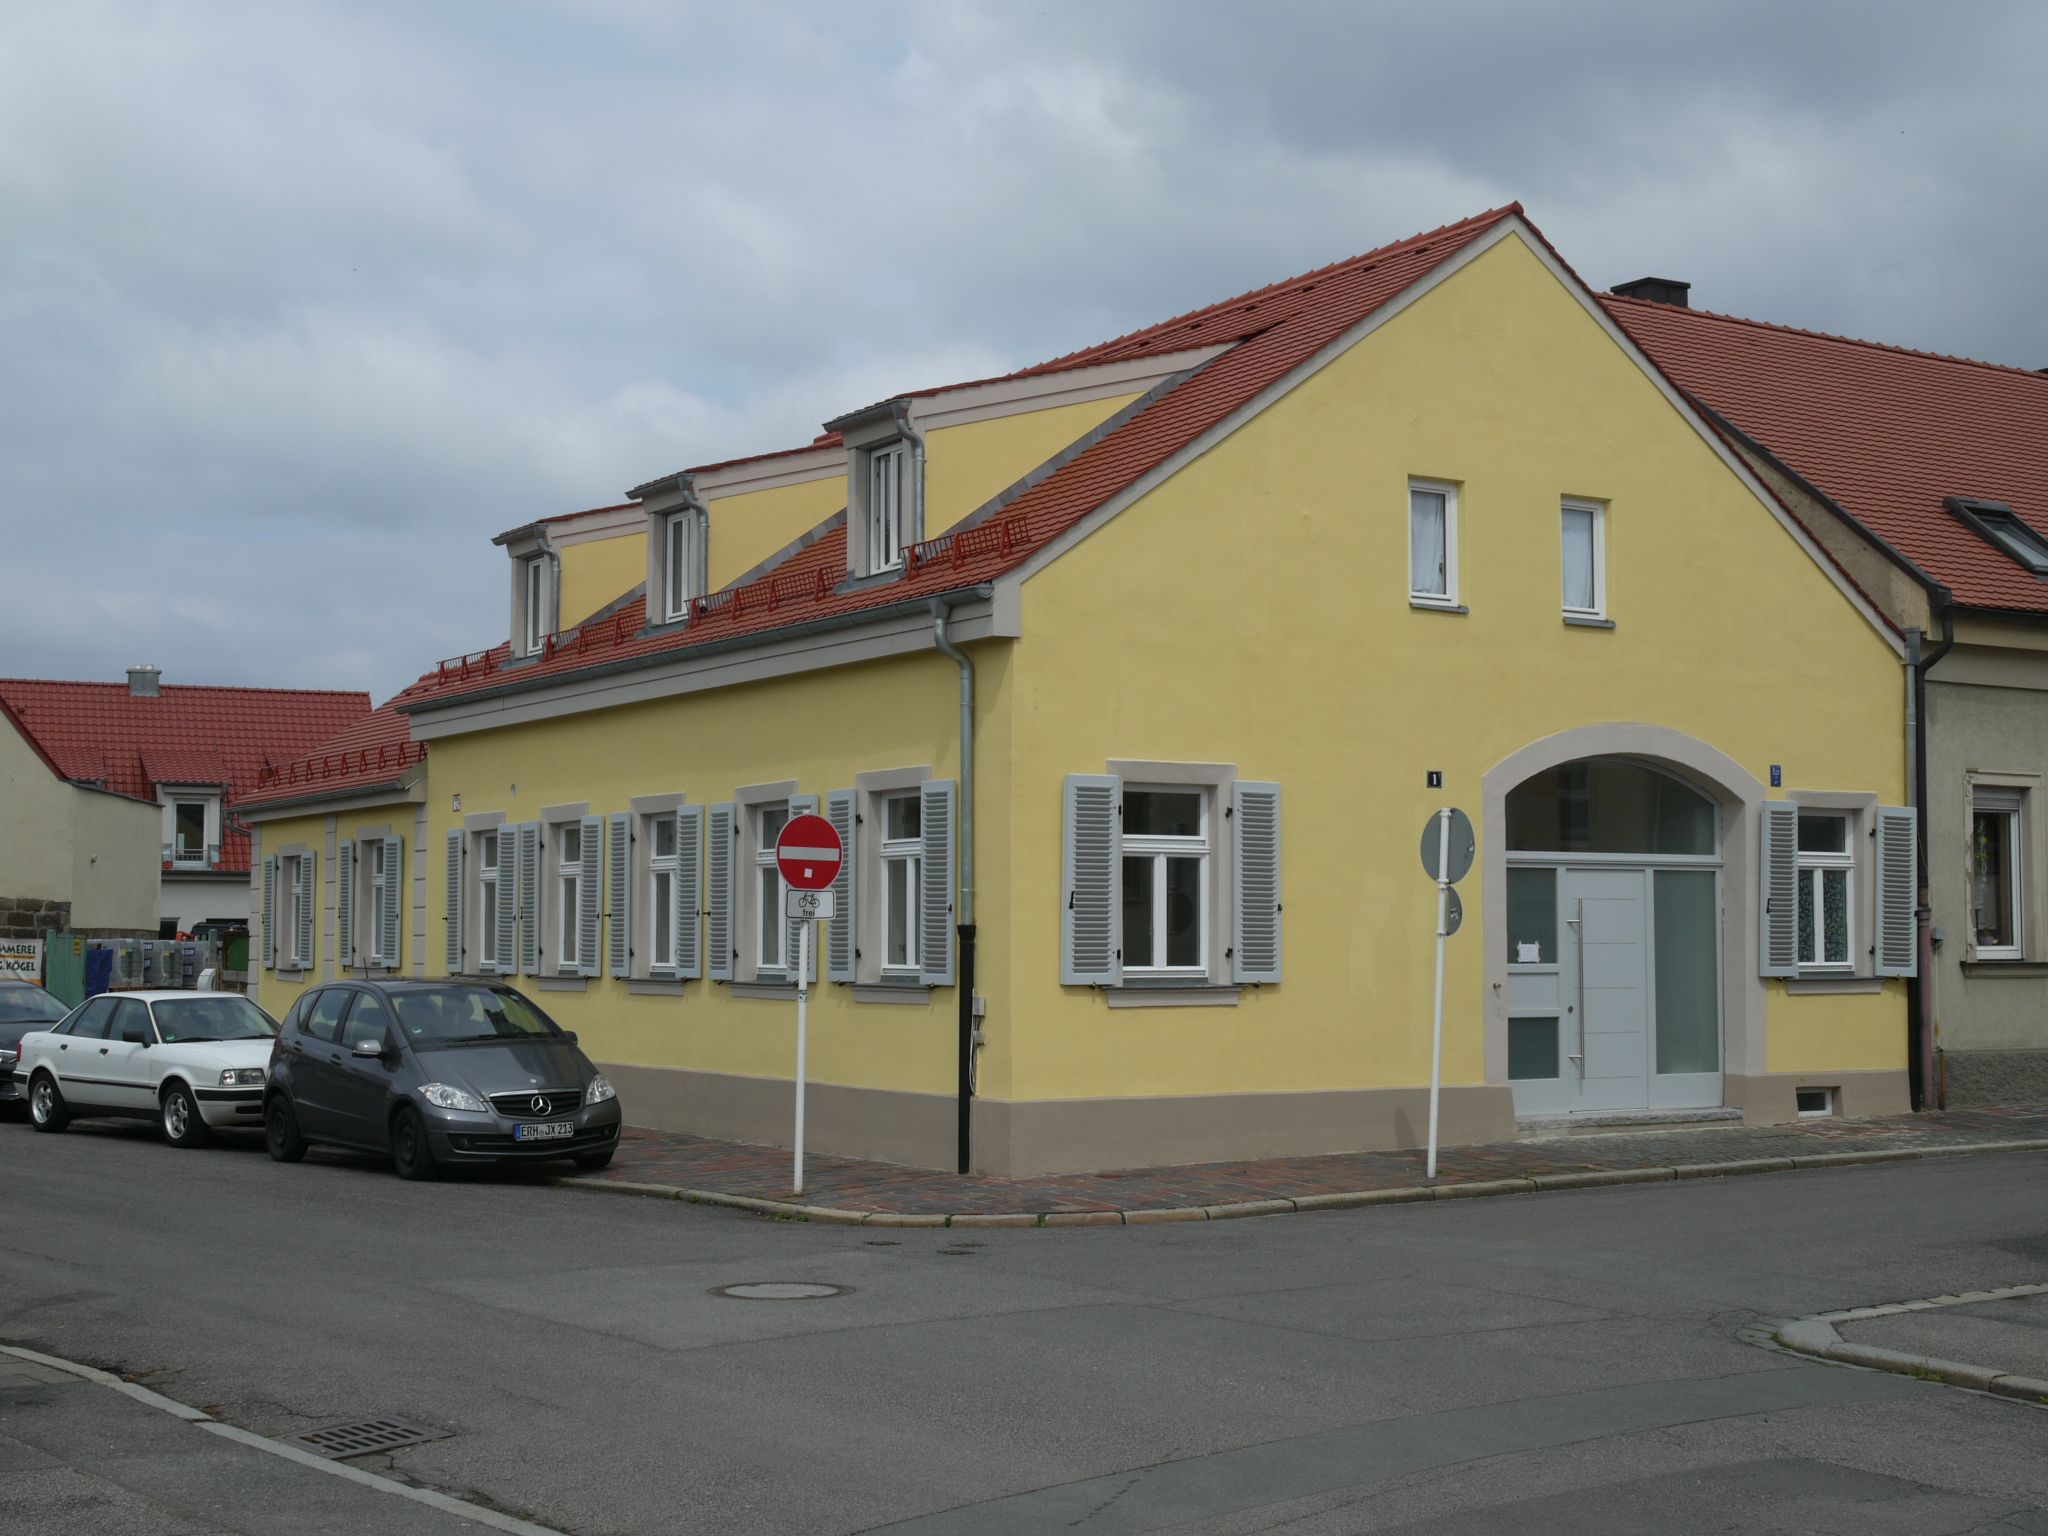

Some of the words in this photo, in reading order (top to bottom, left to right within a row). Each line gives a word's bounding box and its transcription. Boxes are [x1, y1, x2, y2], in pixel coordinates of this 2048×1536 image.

[802, 908, 816, 917] frei
[521, 1126, 539, 1137] ERH
[545, 1125, 556, 1136] JX
[558, 1123, 573, 1134] 213
